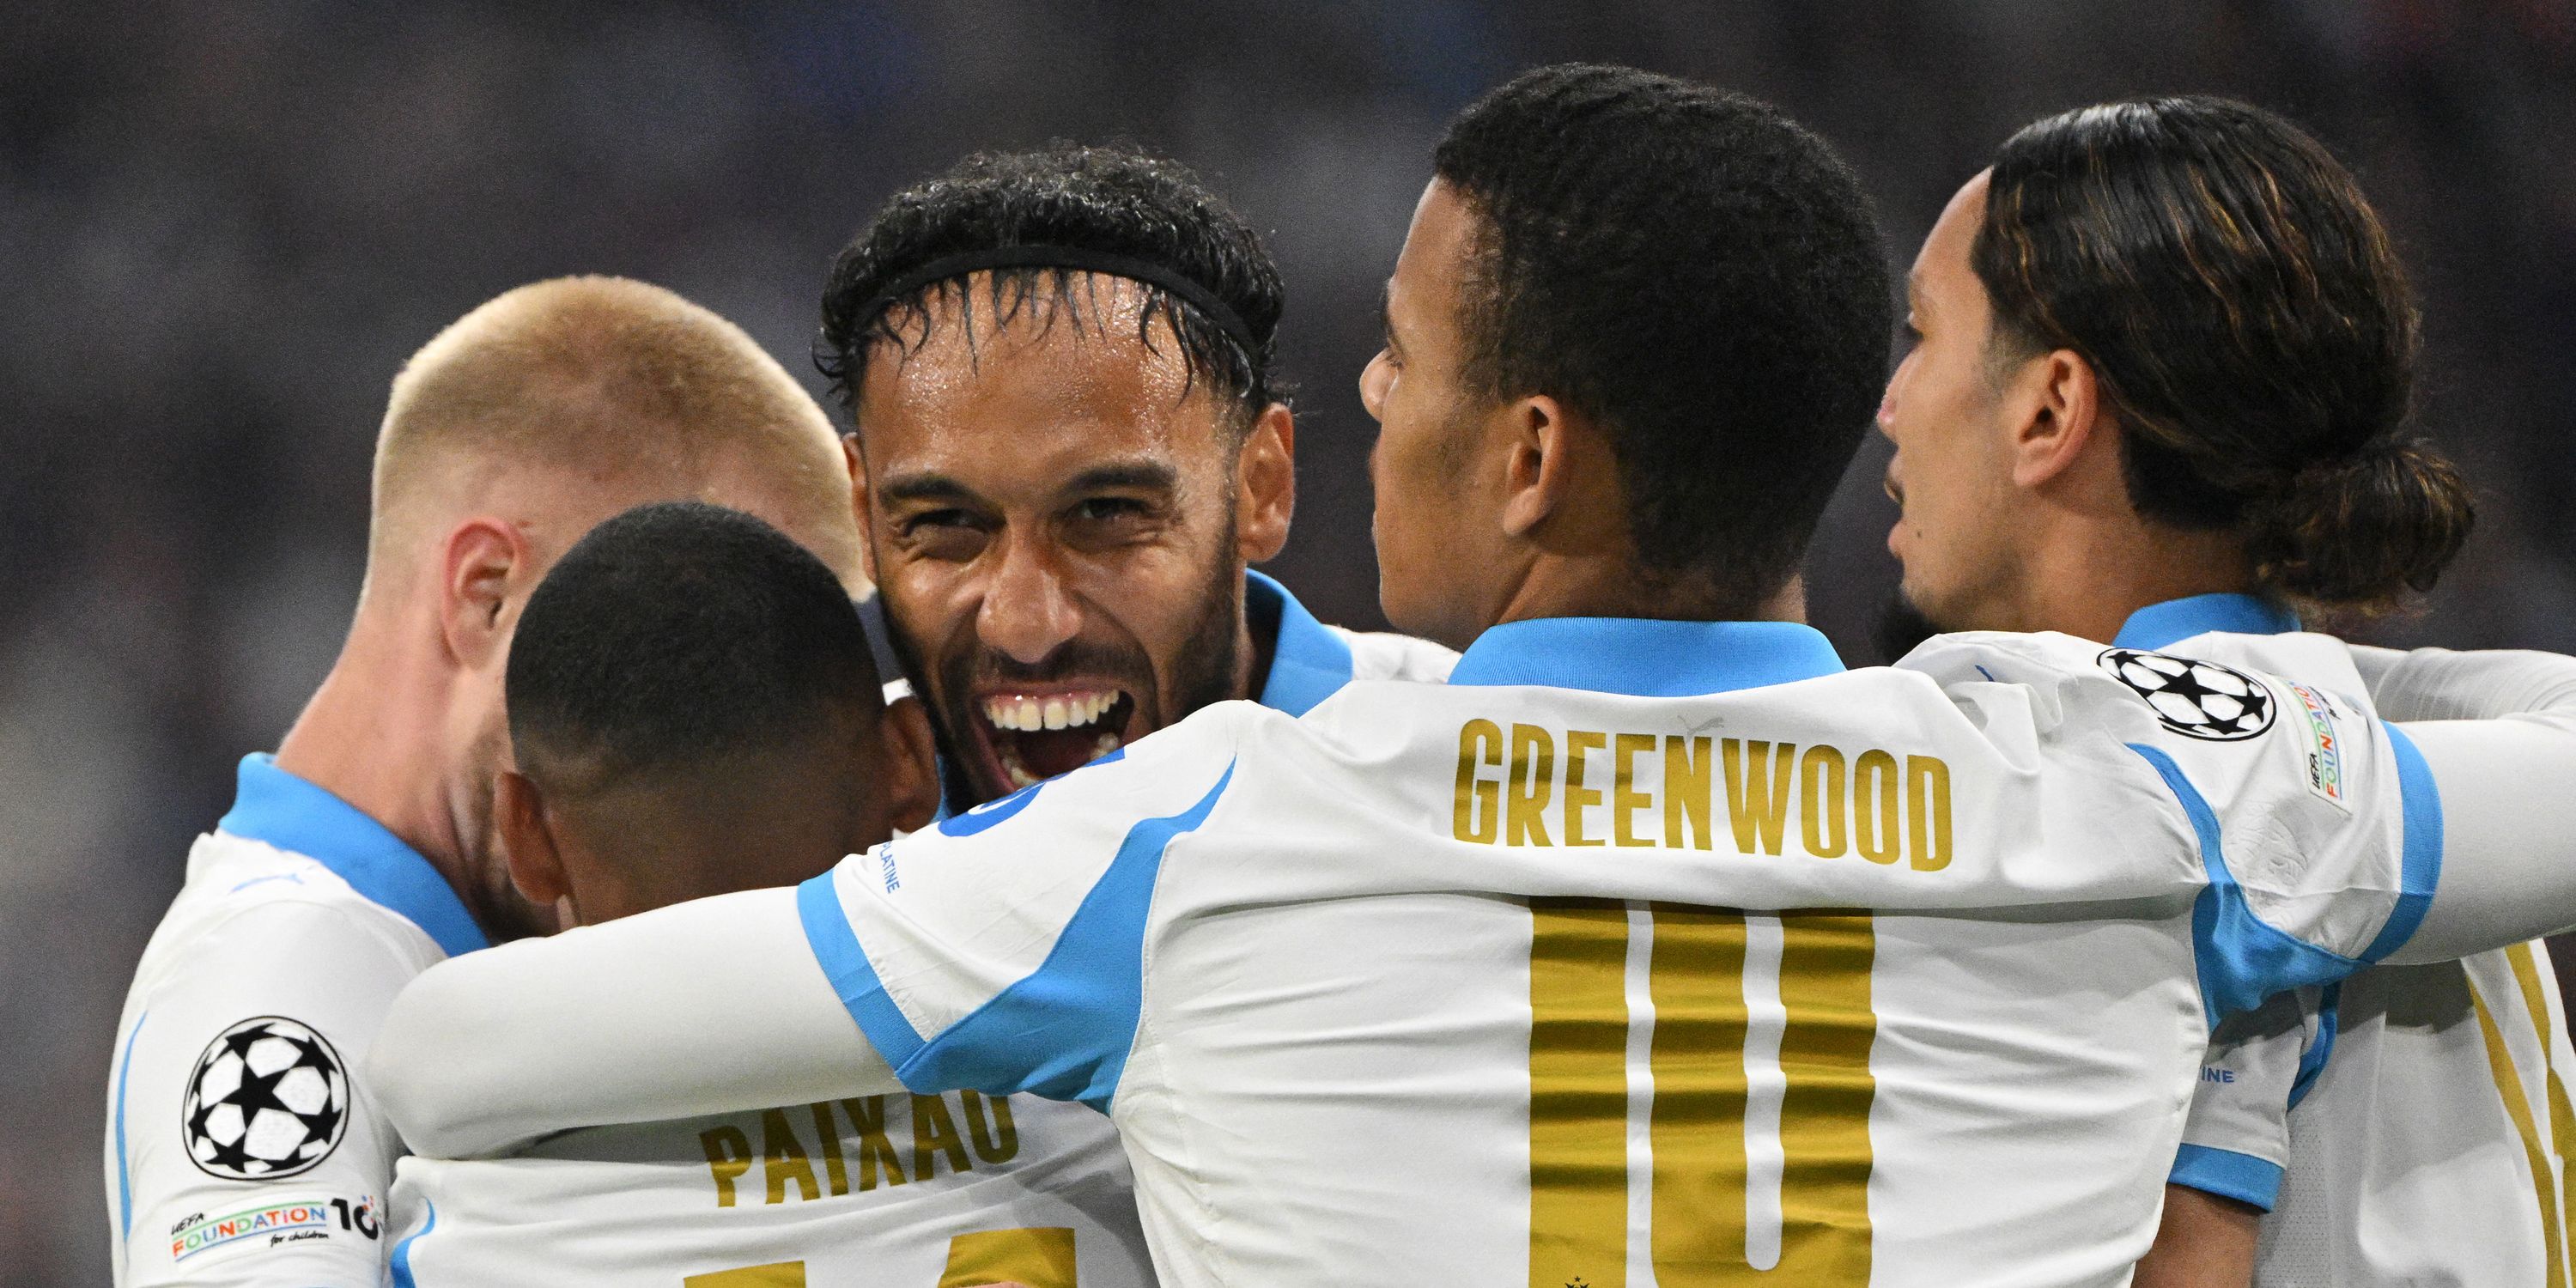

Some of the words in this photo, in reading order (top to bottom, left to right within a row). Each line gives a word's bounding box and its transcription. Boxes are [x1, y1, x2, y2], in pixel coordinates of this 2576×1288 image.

[2309, 752, 2321, 790] UEFA
[1453, 718, 1953, 872] GREENWOOD
[171, 1212, 205, 1236] UEFA
[172, 1207, 327, 1257] FOUNDATION
[270, 1233, 285, 1248] for
[288, 1232, 330, 1242] children
